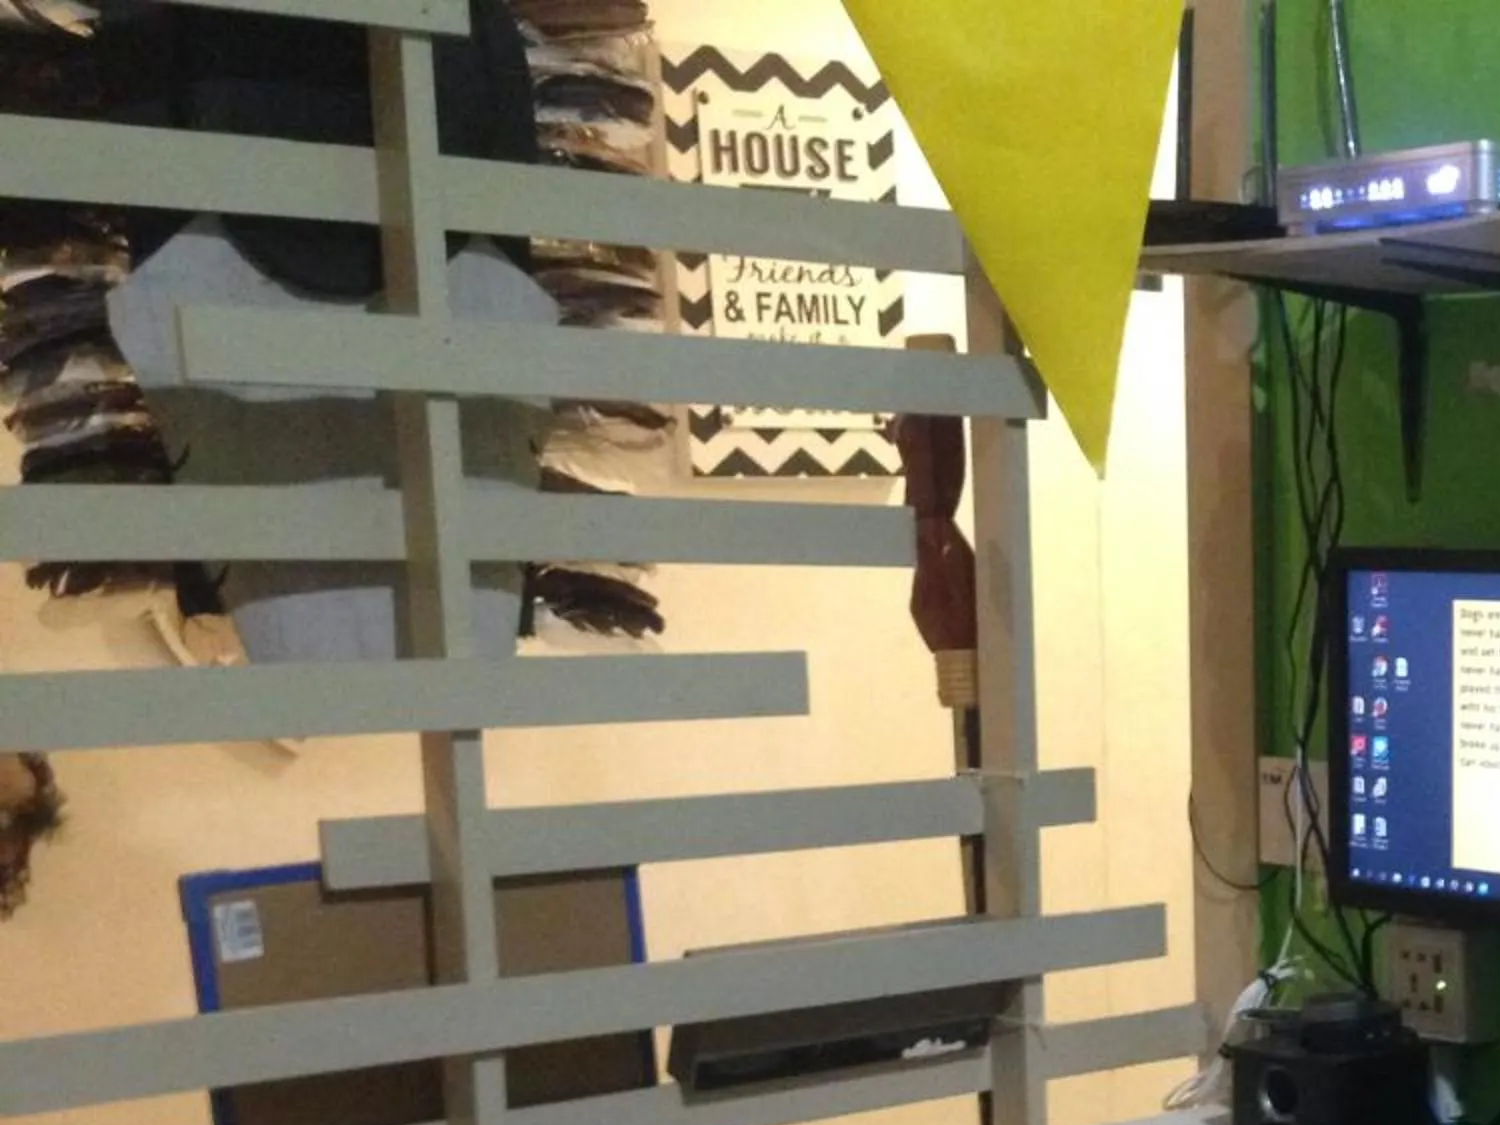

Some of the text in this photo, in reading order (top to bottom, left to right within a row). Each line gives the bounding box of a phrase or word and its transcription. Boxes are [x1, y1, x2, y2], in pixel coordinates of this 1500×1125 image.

[709, 128, 860, 183] HOUSE
[723, 290, 866, 327] & FAMILY
